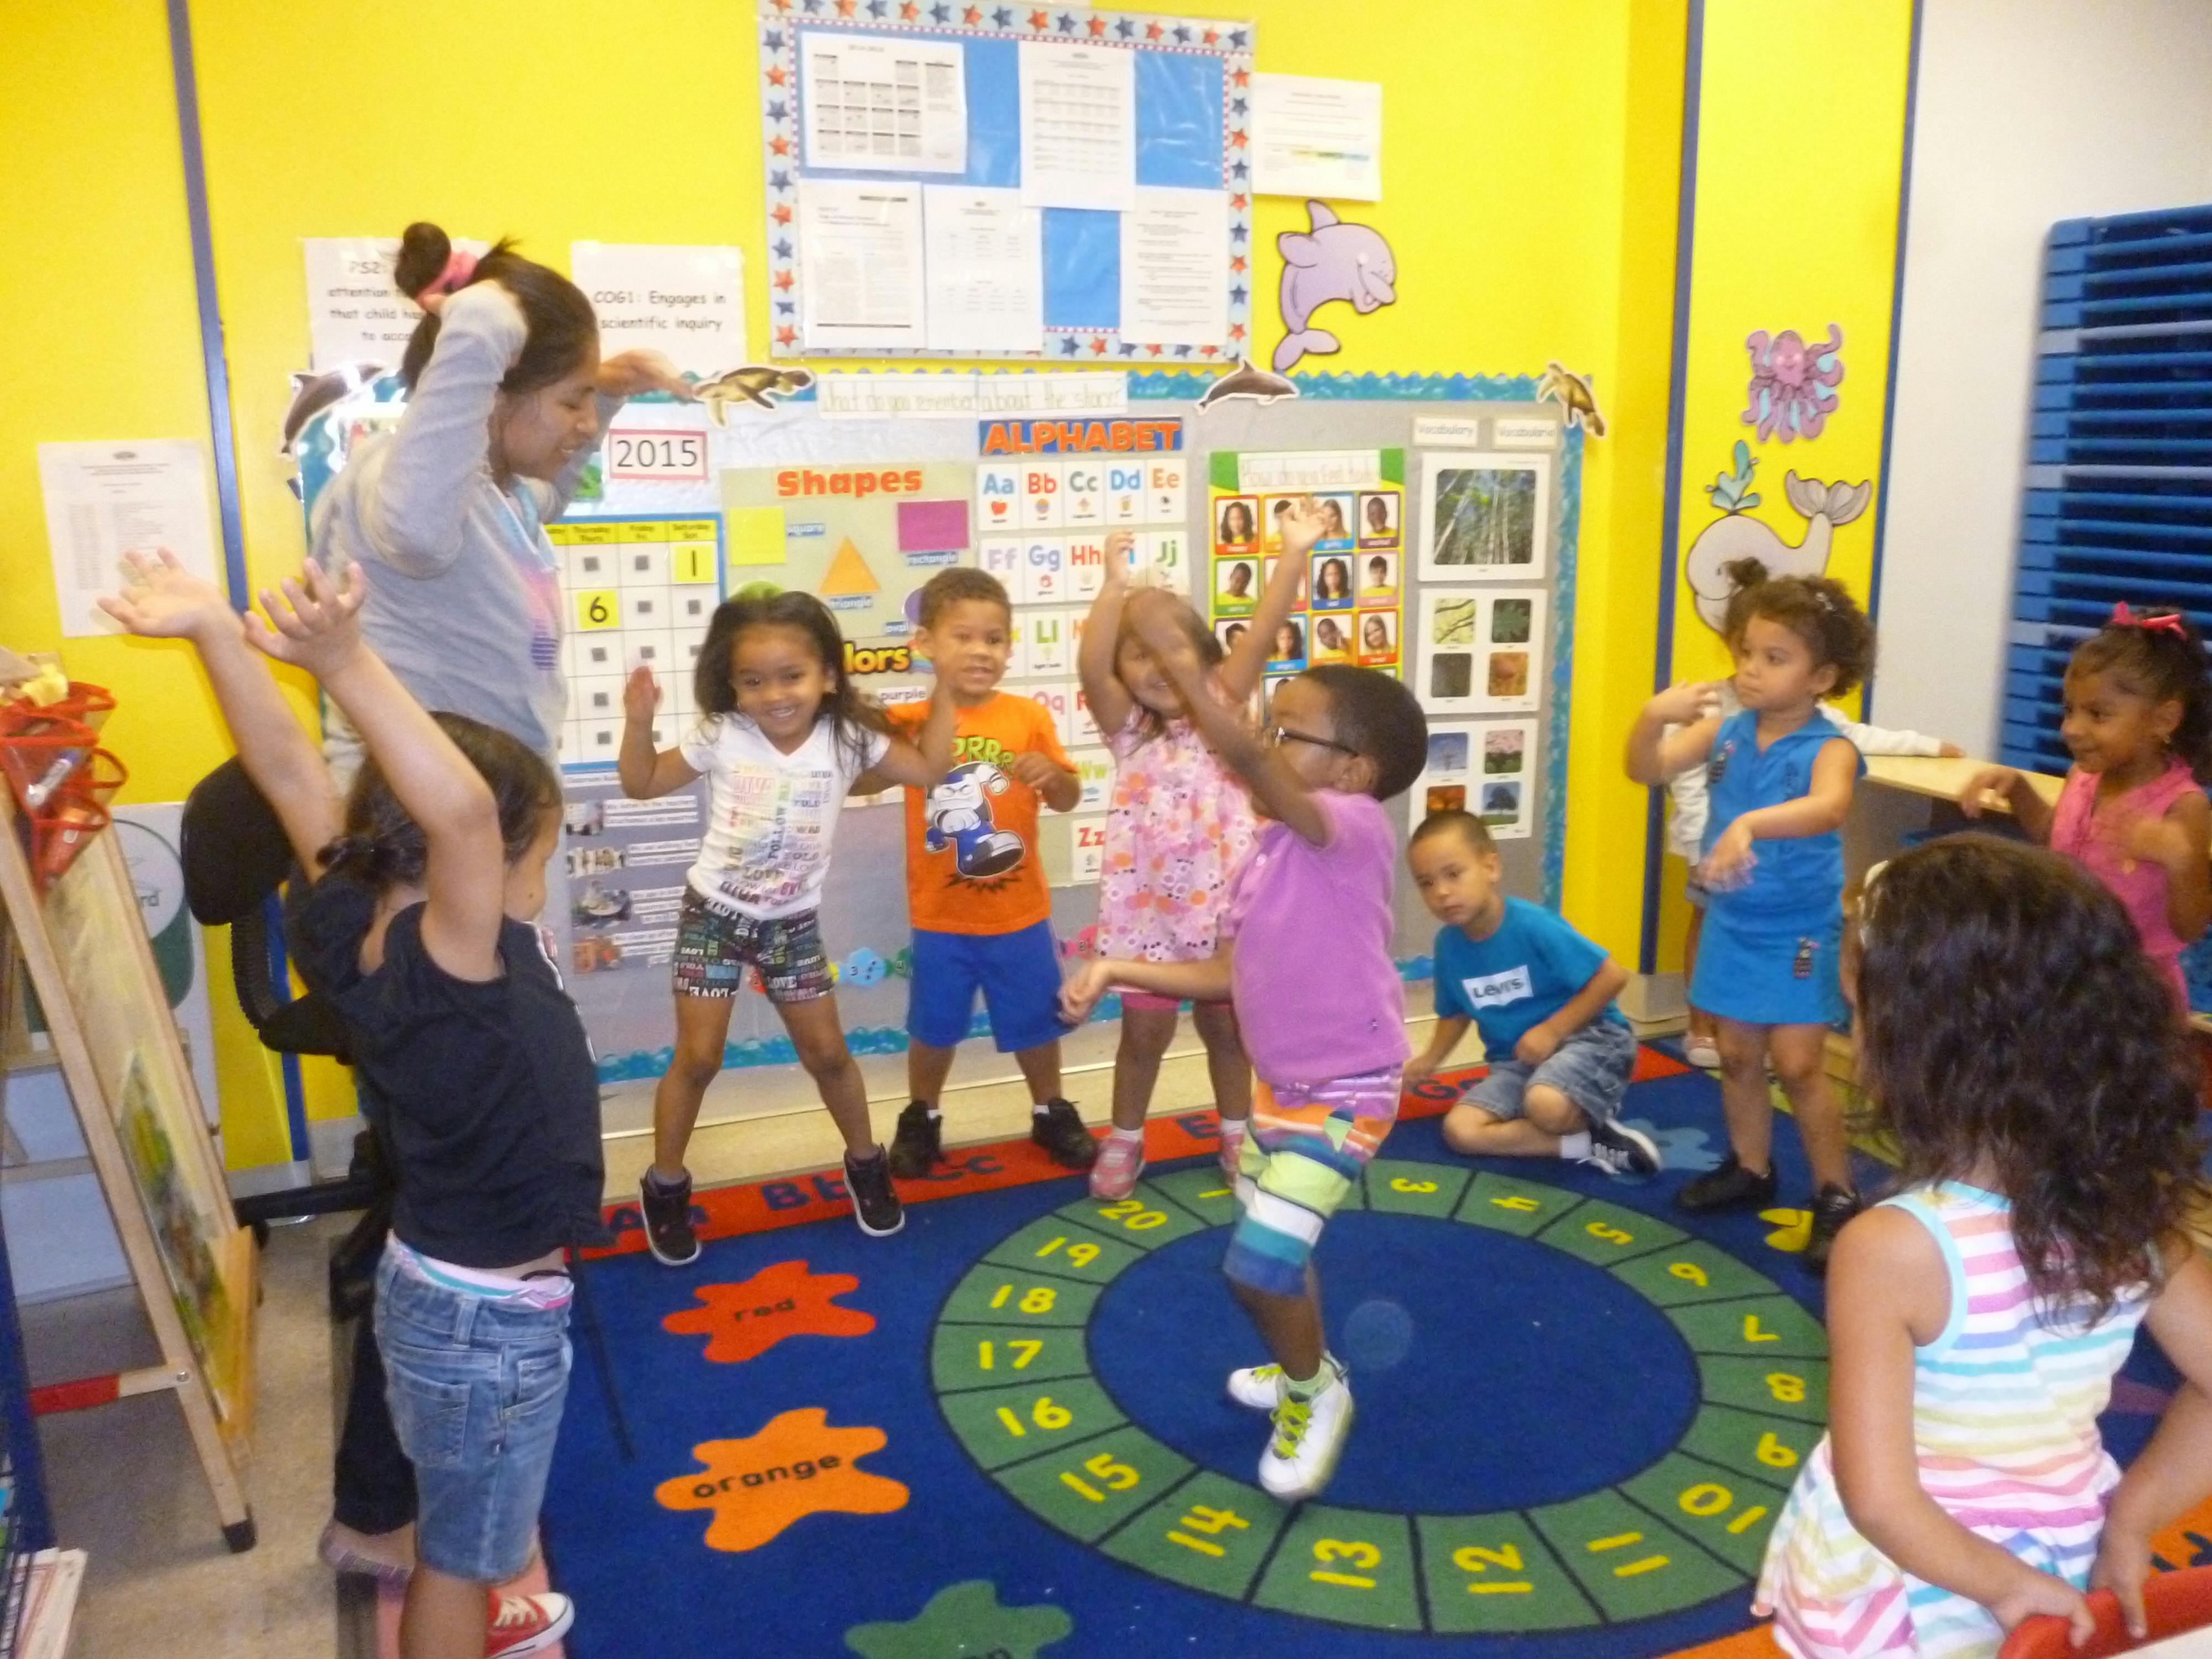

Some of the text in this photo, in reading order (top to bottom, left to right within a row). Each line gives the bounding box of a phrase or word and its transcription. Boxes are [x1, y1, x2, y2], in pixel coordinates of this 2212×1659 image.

[649, 291, 707, 308] Engages
[601, 315, 723, 332] scientific inquiry
[984, 420, 1181, 453] ALPHABET
[616, 440, 698, 468] 2015
[776, 469, 924, 498] Shapes
[983, 473, 1015, 494] Aa
[1027, 472, 1058, 494] Bb
[1069, 471, 1099, 492] Cc
[1110, 468, 1142, 491] Dd
[1151, 468, 1180, 489] Ee
[987, 547, 1017, 571] Ff
[1029, 544, 1061, 572] Gg
[1071, 545, 1102, 566] Hh
[1155, 540, 1178, 567] Jj
[589, 596, 609, 623] 6
[843, 641, 911, 674] lors
[880, 689, 927, 703] purple
[1078, 827, 1106, 848] Zz
[688, 986, 730, 998] LOVE
[1390, 1177, 1438, 1194] 3
[1098, 1199, 1169, 1231] 20
[1491, 1195, 1539, 1212] 4
[1585, 1221, 1633, 1245] 5
[1036, 1237, 1100, 1268] 19
[733, 1296, 796, 1323] red
[990, 1284, 1057, 1315] 18
[1743, 1314, 1780, 1343] 7
[978, 1338, 1043, 1370] 17
[1765, 1371, 1806, 1404] 8
[998, 1397, 1072, 1437] 16
[692, 1453, 842, 1500] orange
[1060, 1453, 1140, 1503] 15
[1678, 1481, 1768, 1535] 10
[1166, 1505, 1249, 1558] 14
[1310, 1538, 1382, 1589] 13
[1587, 1531, 1670, 1578] 11
[1452, 1543, 1532, 1595] 12
